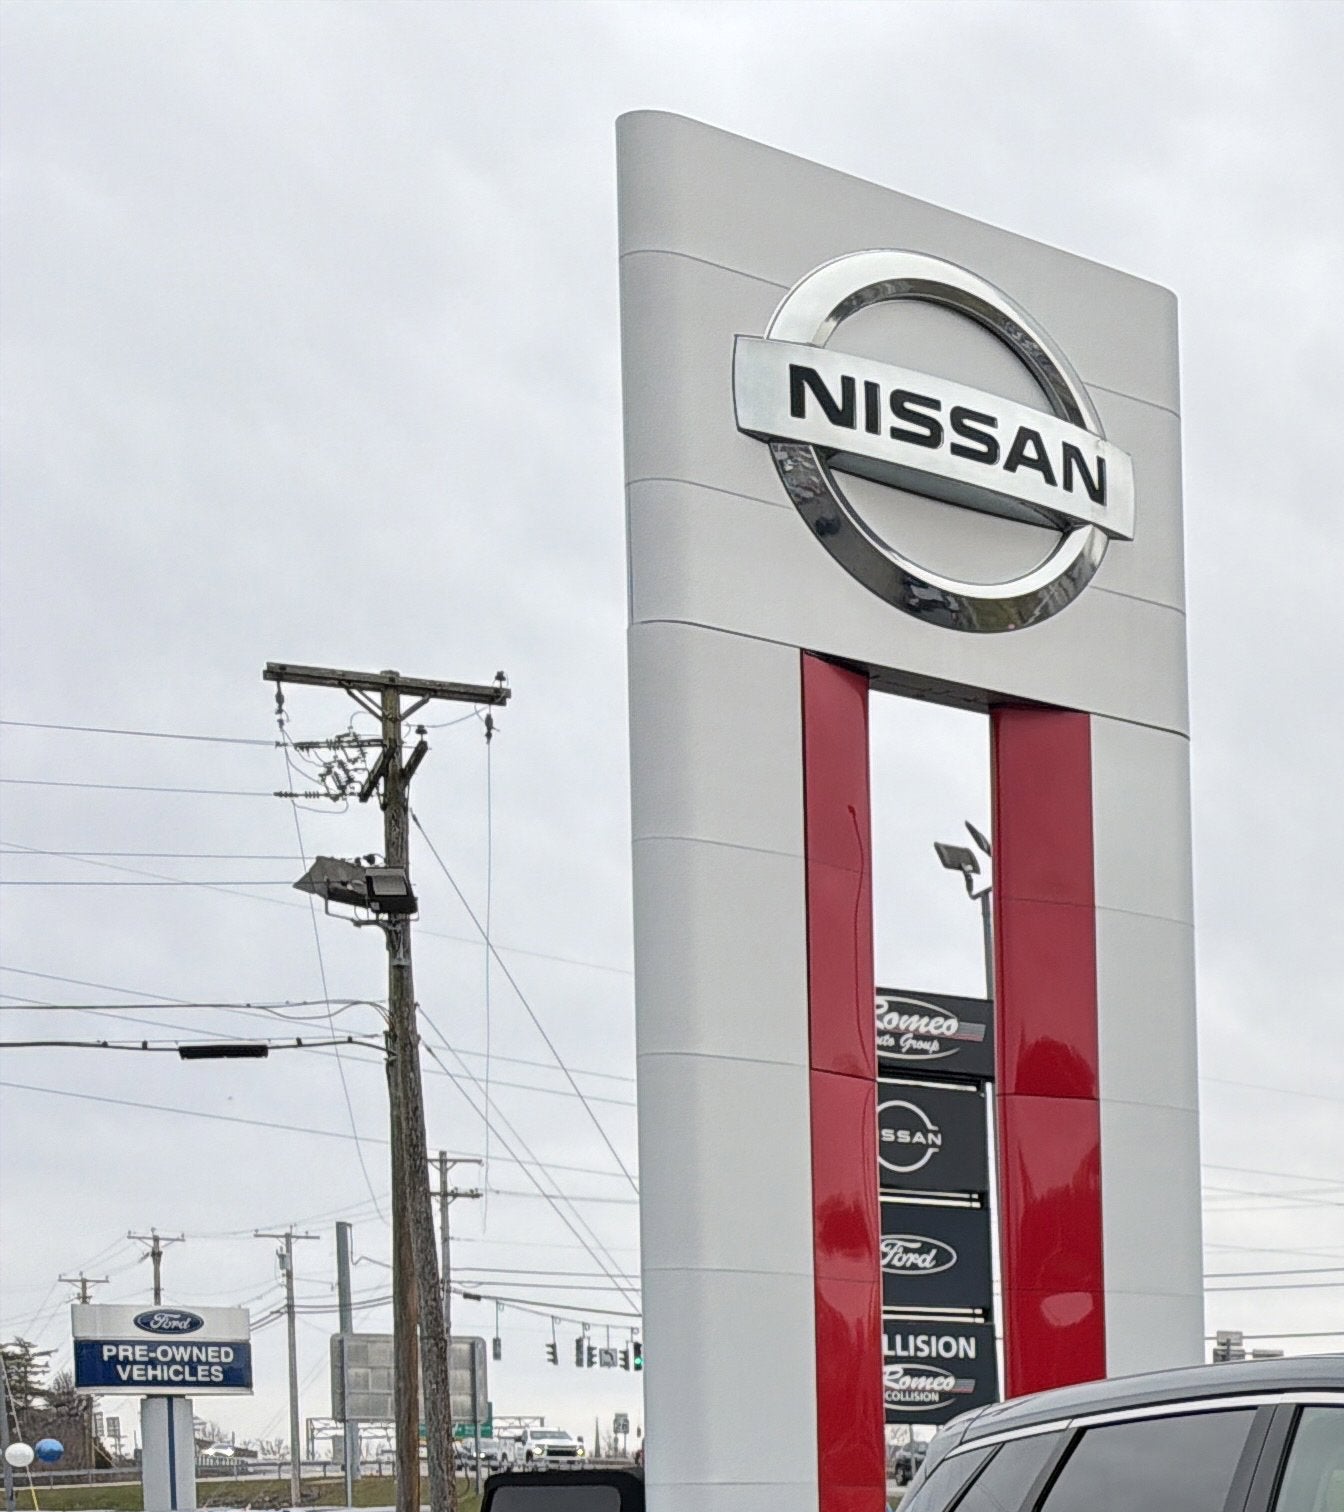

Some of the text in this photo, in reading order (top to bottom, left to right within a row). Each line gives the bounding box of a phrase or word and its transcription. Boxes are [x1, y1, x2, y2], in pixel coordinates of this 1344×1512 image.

[788, 362, 1108, 507] NISSAN
[900, 1033, 940, 1055] Group
[880, 1127, 942, 1146] SSAN
[880, 1239, 938, 1269] Ford
[149, 1312, 192, 1330] Ford
[102, 1344, 234, 1363] PRE-OWNED
[881, 1333, 976, 1359] LLISION
[116, 1364, 224, 1382] VEHICLES
[885, 1390, 940, 1402] COLLISION
